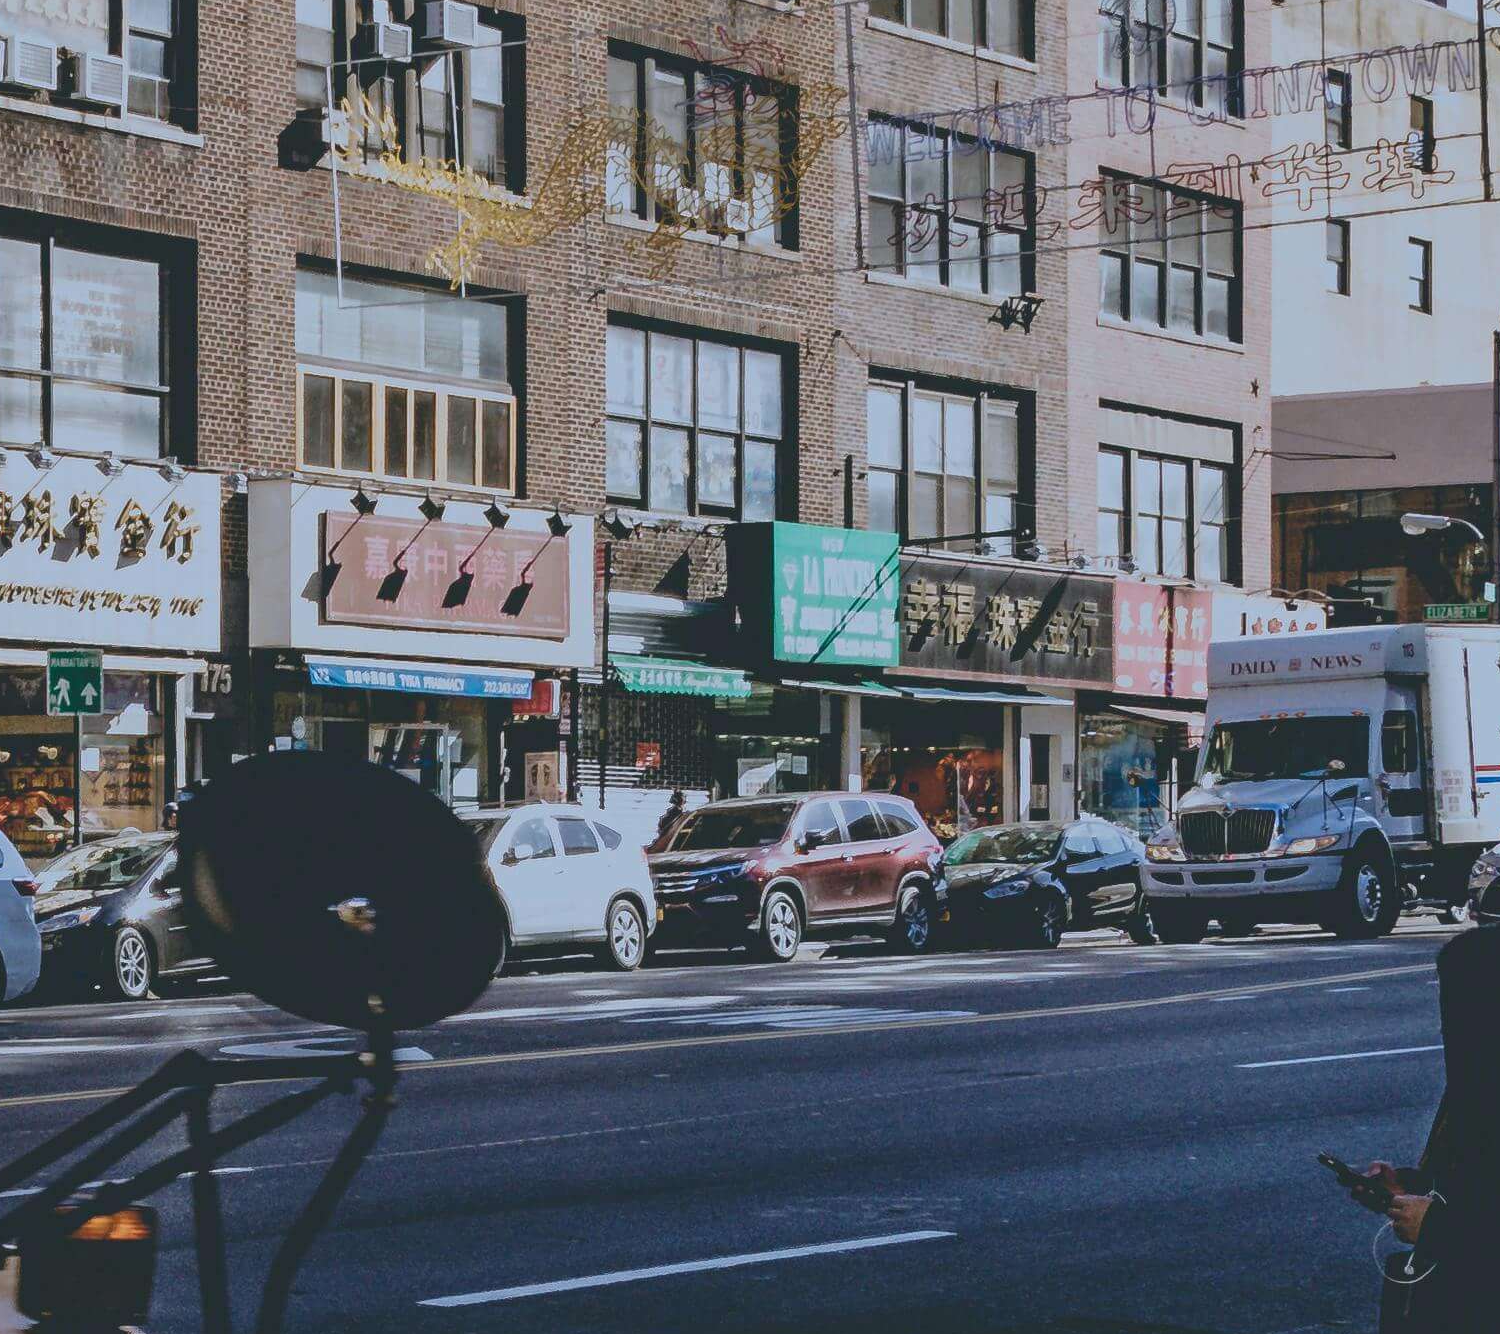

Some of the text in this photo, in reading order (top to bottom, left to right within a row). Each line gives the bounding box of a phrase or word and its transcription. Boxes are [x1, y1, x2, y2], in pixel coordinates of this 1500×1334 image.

[863, 39, 1481, 167] WELCOME TO CHINATOWN
[1426, 606, 1477, 620] ELIZABETH
[1231, 654, 1363, 676] DAILY NEWS
